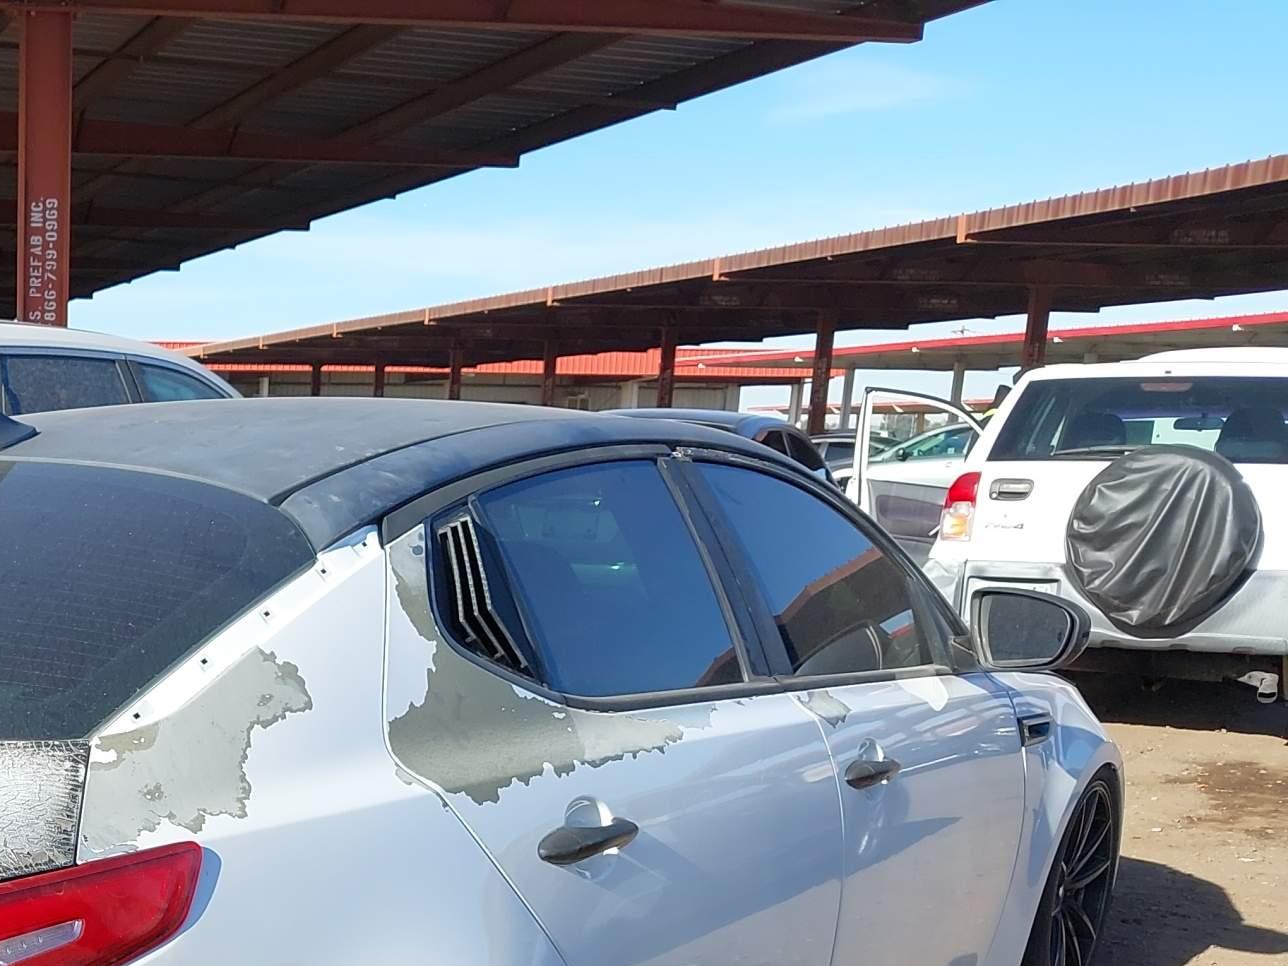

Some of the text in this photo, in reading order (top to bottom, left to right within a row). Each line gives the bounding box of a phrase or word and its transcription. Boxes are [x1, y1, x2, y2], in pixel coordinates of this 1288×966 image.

[29, 196, 44, 321] S. PREFAB INC.
